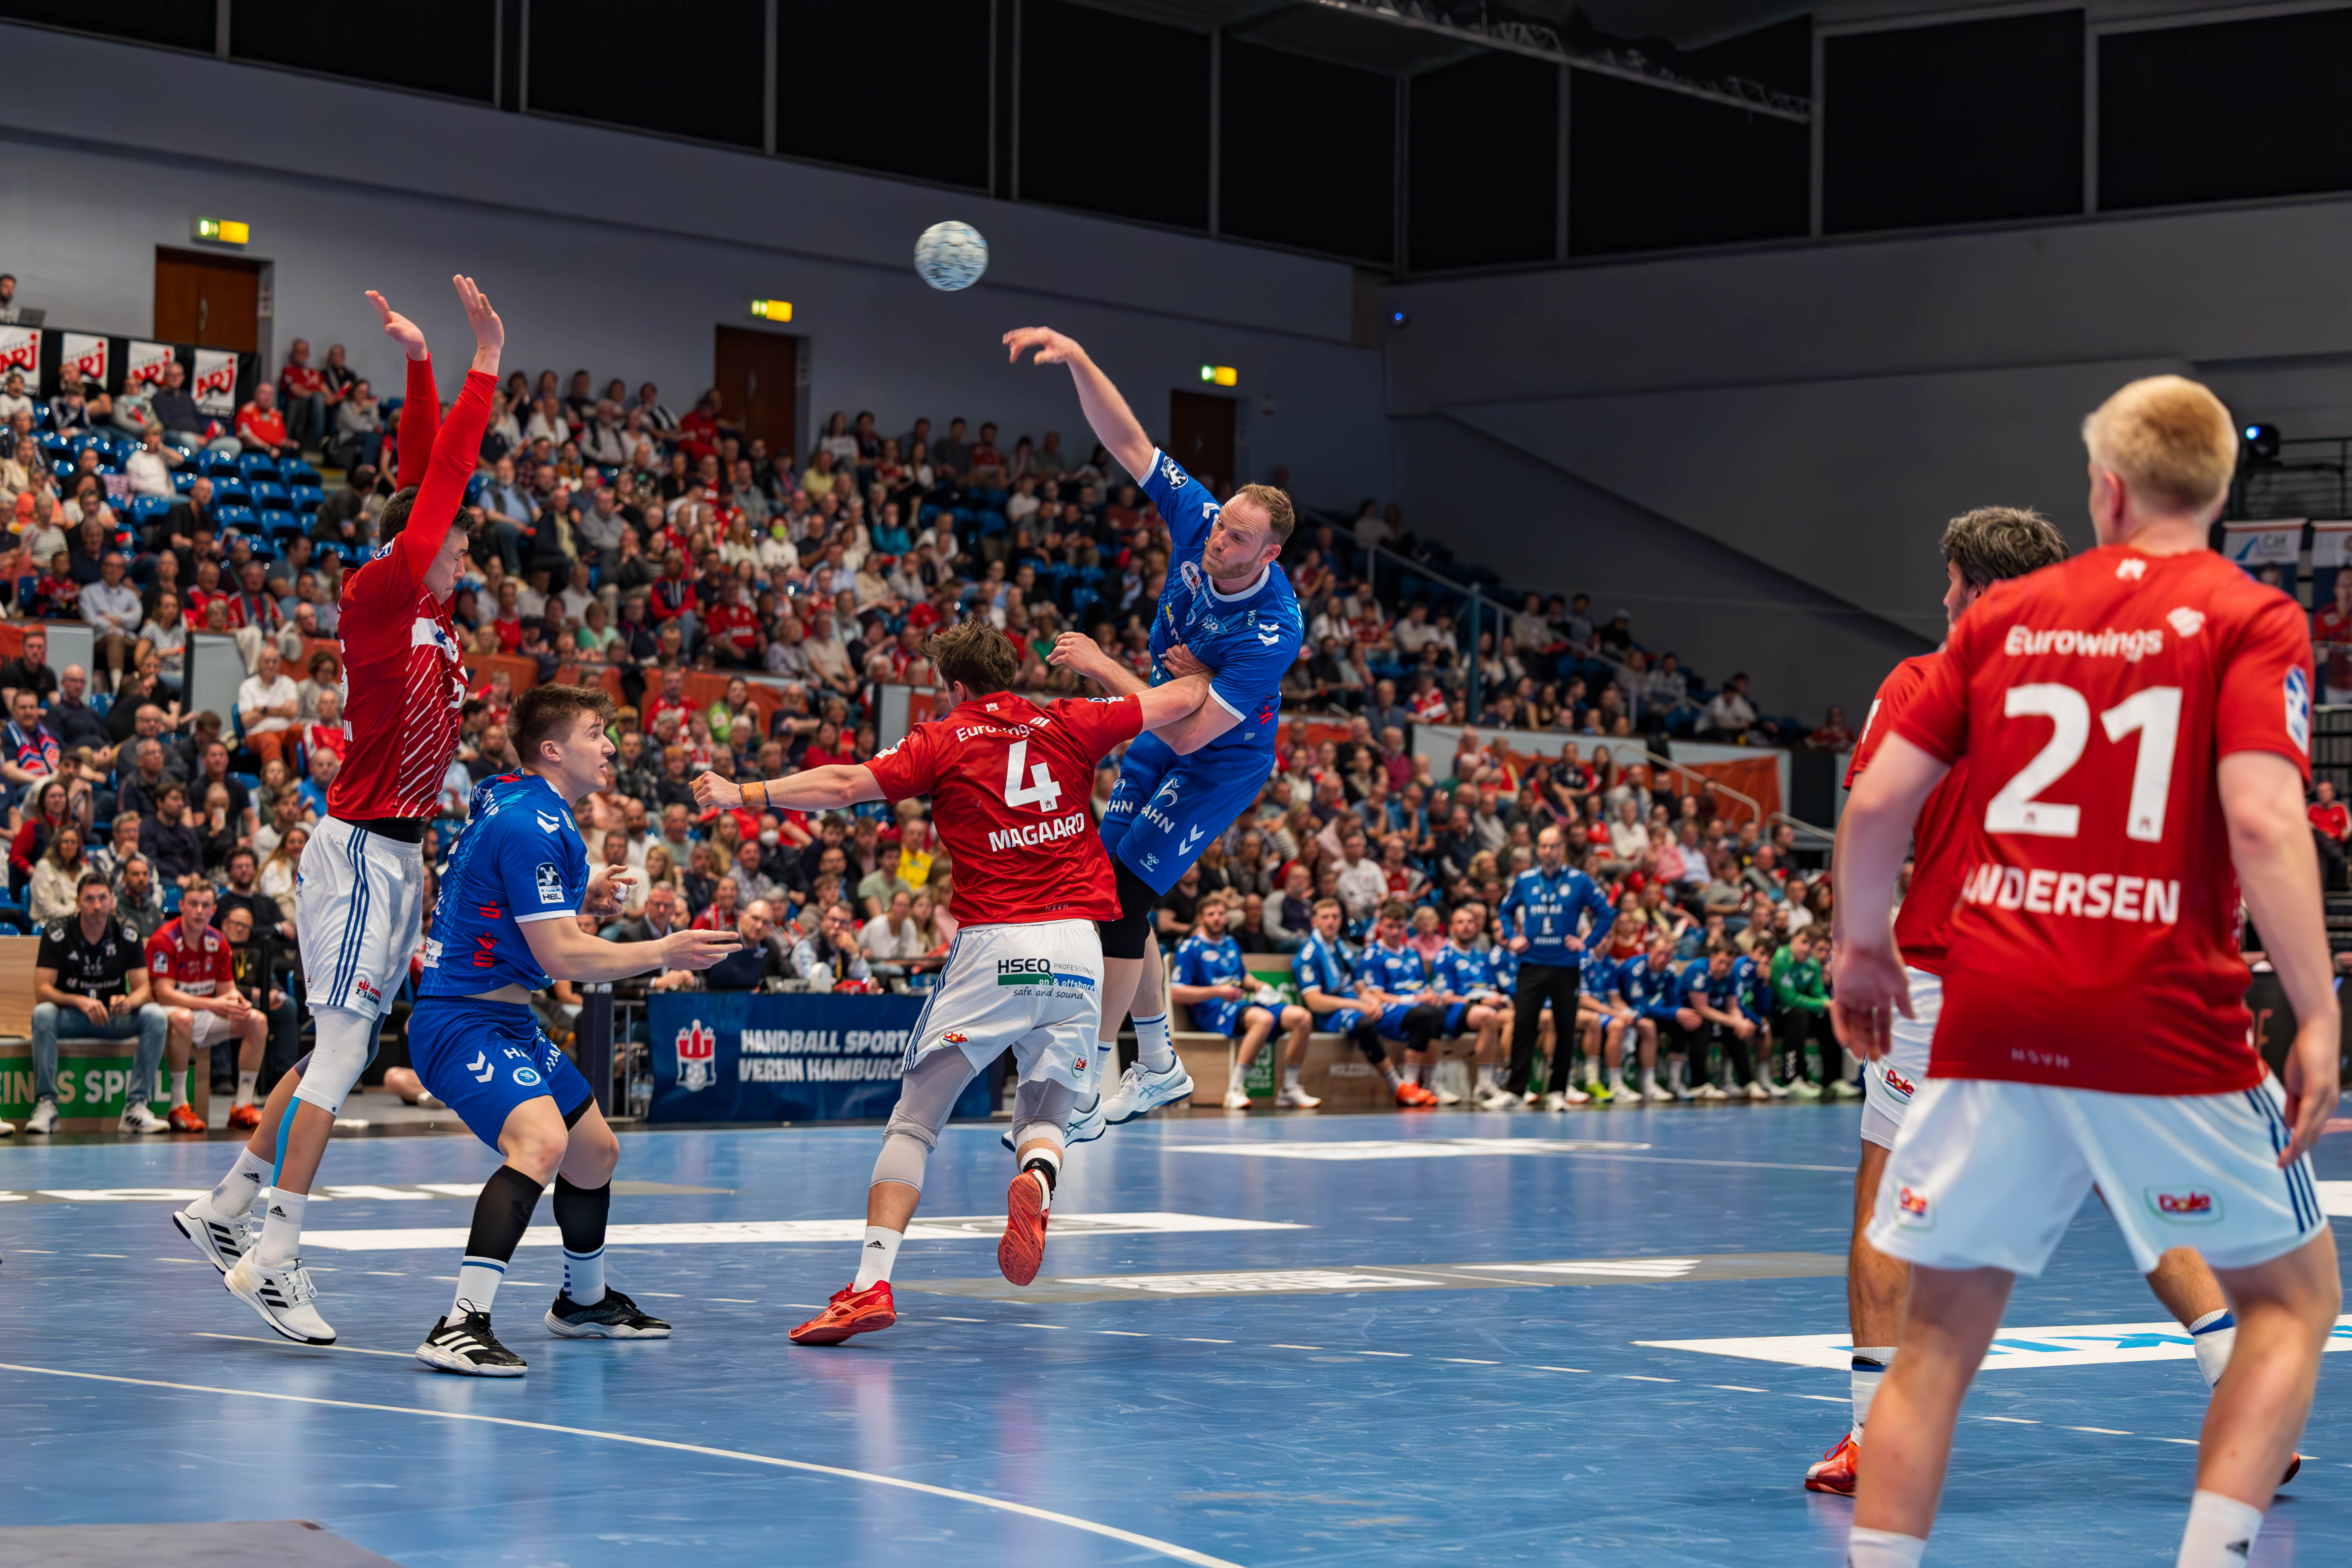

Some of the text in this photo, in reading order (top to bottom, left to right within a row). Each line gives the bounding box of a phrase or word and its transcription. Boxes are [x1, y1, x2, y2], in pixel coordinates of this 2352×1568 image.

[1247, 610, 1257, 626] WGV
[2004, 624, 2164, 663] Eurowings
[1984, 682, 2183, 843] 21
[1004, 739, 1062, 813] 4
[988, 813, 1084, 852] MAGAARD
[1139, 859, 1154, 873] hummel
[1045, 903, 1069, 911] HSVH
[998, 958, 1096, 978] HSEQ PROFESSIONAL
[1013, 986, 1084, 1000] safe and sound
[1062, 980, 1094, 991] offshore
[740, 1029, 909, 1054] HANDBALL SPORT
[738, 1057, 903, 1082] VEREIN HAMBURG
[1886, 1069, 1915, 1095] Dole
[2158, 1190, 2211, 1212] Dole
